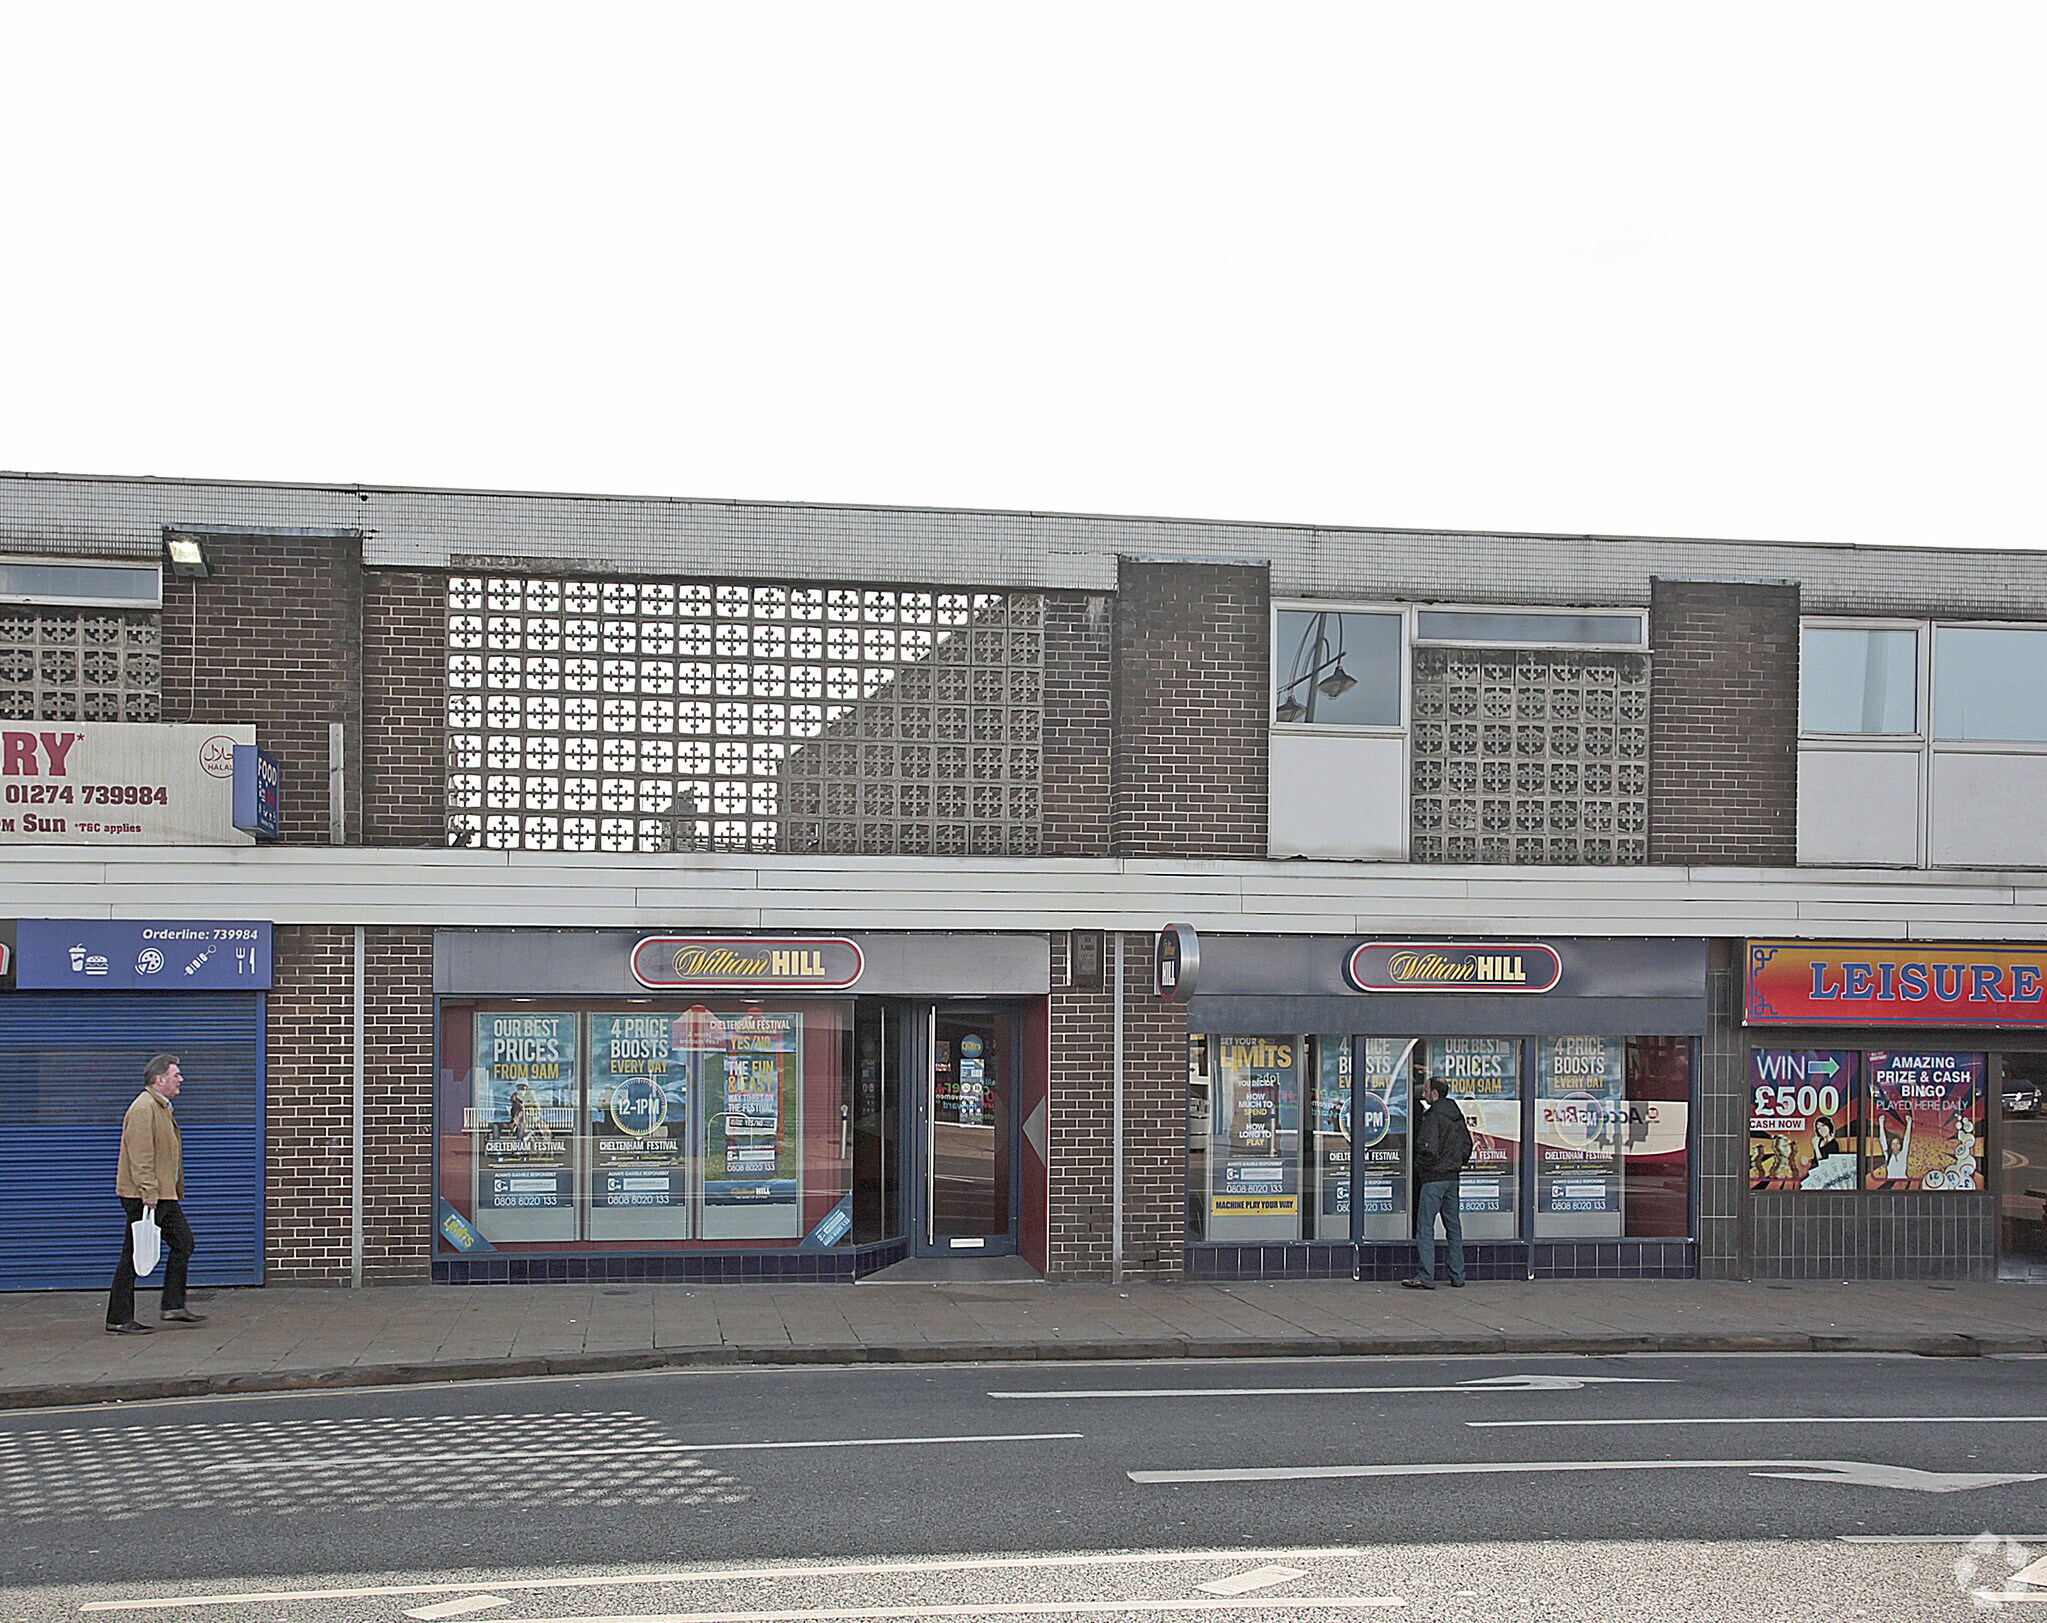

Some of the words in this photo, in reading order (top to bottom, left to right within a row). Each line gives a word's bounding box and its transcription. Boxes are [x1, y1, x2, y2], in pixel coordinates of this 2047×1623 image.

[258, 757, 277, 787] FOOD
[5, 784, 74, 804] 01274
[81, 785, 168, 805] 739984
[0, 818, 15, 832] M
[23, 813, 66, 833] Sun
[104, 823, 142, 835] applies
[142, 929, 210, 940] Orderline:
[213, 929, 258, 940] 739984
[672, 945, 771, 979] William
[771, 950, 826, 976] HILL
[1387, 951, 1478, 984] William
[1477, 956, 1527, 981] HILL
[1809, 962, 2044, 1002] LEISURE
[494, 1018, 520, 1038] OUR
[524, 1018, 559, 1038] BEST
[611, 1019, 622, 1038] 4
[625, 1019, 669, 1038] PRICE
[710, 1020, 755, 1030] CHELTENHAM
[757, 1020, 790, 1030] FESTIVAL
[731, 1036, 771, 1050] YES/NO
[1220, 1037, 1233, 1045] SET
[1234, 1037, 1257, 1045] YOUR
[1340, 1037, 1349, 1055] 4
[1445, 1039, 1468, 1053] OUR
[1471, 1039, 1499, 1053] BEST
[1554, 1037, 1564, 1055] 4
[1567, 1037, 1605, 1055] PRICE
[494, 1039, 560, 1062] PRICES
[611, 1039, 669, 1059] BOOSTS
[1220, 1041, 1292, 1071] LIMITS
[611, 1059, 645, 1073] EVERY
[647, 1059, 669, 1073] DAY
[728, 1060, 749, 1075] THE
[752, 1060, 774, 1075] FUN
[1339, 1056, 1391, 1074] BSTS
[1445, 1055, 1501, 1077] PRICES
[1554, 1056, 1605, 1074] BOOSTS
[1756, 1055, 1805, 1080] WIN
[1892, 1057, 1955, 1068] AMAZING
[494, 1063, 529, 1079] FROM
[531, 1063, 559, 1079] 9AM
[1876, 1071, 1916, 1082] PRIZE
[1920, 1071, 1929, 1082] &
[1933, 1071, 1970, 1082] CASH
[728, 1076, 737, 1093] &
[741, 1076, 774, 1093] EASY
[1339, 1075, 1370, 1088] EVY
[1372, 1075, 1392, 1088] DAY
[1477, 1078, 1501, 1093] 9AM
[1554, 1075, 1585, 1088] EVERY
[1586, 1075, 1605, 1088] DAY
[1901, 1085, 1946, 1097] BINGO
[619, 1098, 660, 1115] 12-1PM
[1755, 1085, 1839, 1116] £500
[1876, 1100, 1912, 1110] PLAYED
[1914, 1100, 1940, 1110] HERE
[1942, 1100, 1969, 1110] DAILY
[742, 1103, 774, 1113] FESTIVAL
[1344, 1111, 1384, 1127] 1PM
[1750, 1120, 1775, 1128] CASH
[1778, 1120, 1802, 1128] NOW
[486, 1142, 531, 1151] CHELTENHAM
[534, 1141, 566, 1151] FESTIVAL
[600, 1141, 644, 1150] CHELTENHAM
[647, 1140, 678, 1150] FESTIVAL
[1329, 1152, 1370, 1161] CHELTEM
[1372, 1152, 1400, 1160] FESTIVAL
[1480, 1150, 1507, 1159] FESTIVAL
[1545, 1151, 1583, 1160] CHELTENHAM
[1586, 1151, 1613, 1159] FESTIVAL
[756, 1187, 771, 1195] HILL
[1226, 1184, 1246, 1193] 0808
[1248, 1184, 1268, 1193] 8020
[1270, 1184, 1283, 1193] 133
[494, 1197, 516, 1206] 0808
[518, 1197, 541, 1206] 8020
[543, 1196, 557, 1205] 133
[608, 1196, 629, 1205] 0808
[631, 1195, 653, 1204] 8020
[656, 1195, 670, 1204] 133
[1216, 1201, 1245, 1209] MACHINE
[1245, 1201, 1260, 1209] PLAY
[1261, 1200, 1278, 1209] YOUR
[1279, 1200, 1294, 1208] WAY
[1380, 1203, 1392, 1211] 133
[1466, 1202, 1485, 1210] 8020
[1488, 1202, 1499, 1210] 133
[1551, 1202, 1570, 1210] 0808
[1572, 1202, 1591, 1210] 8020
